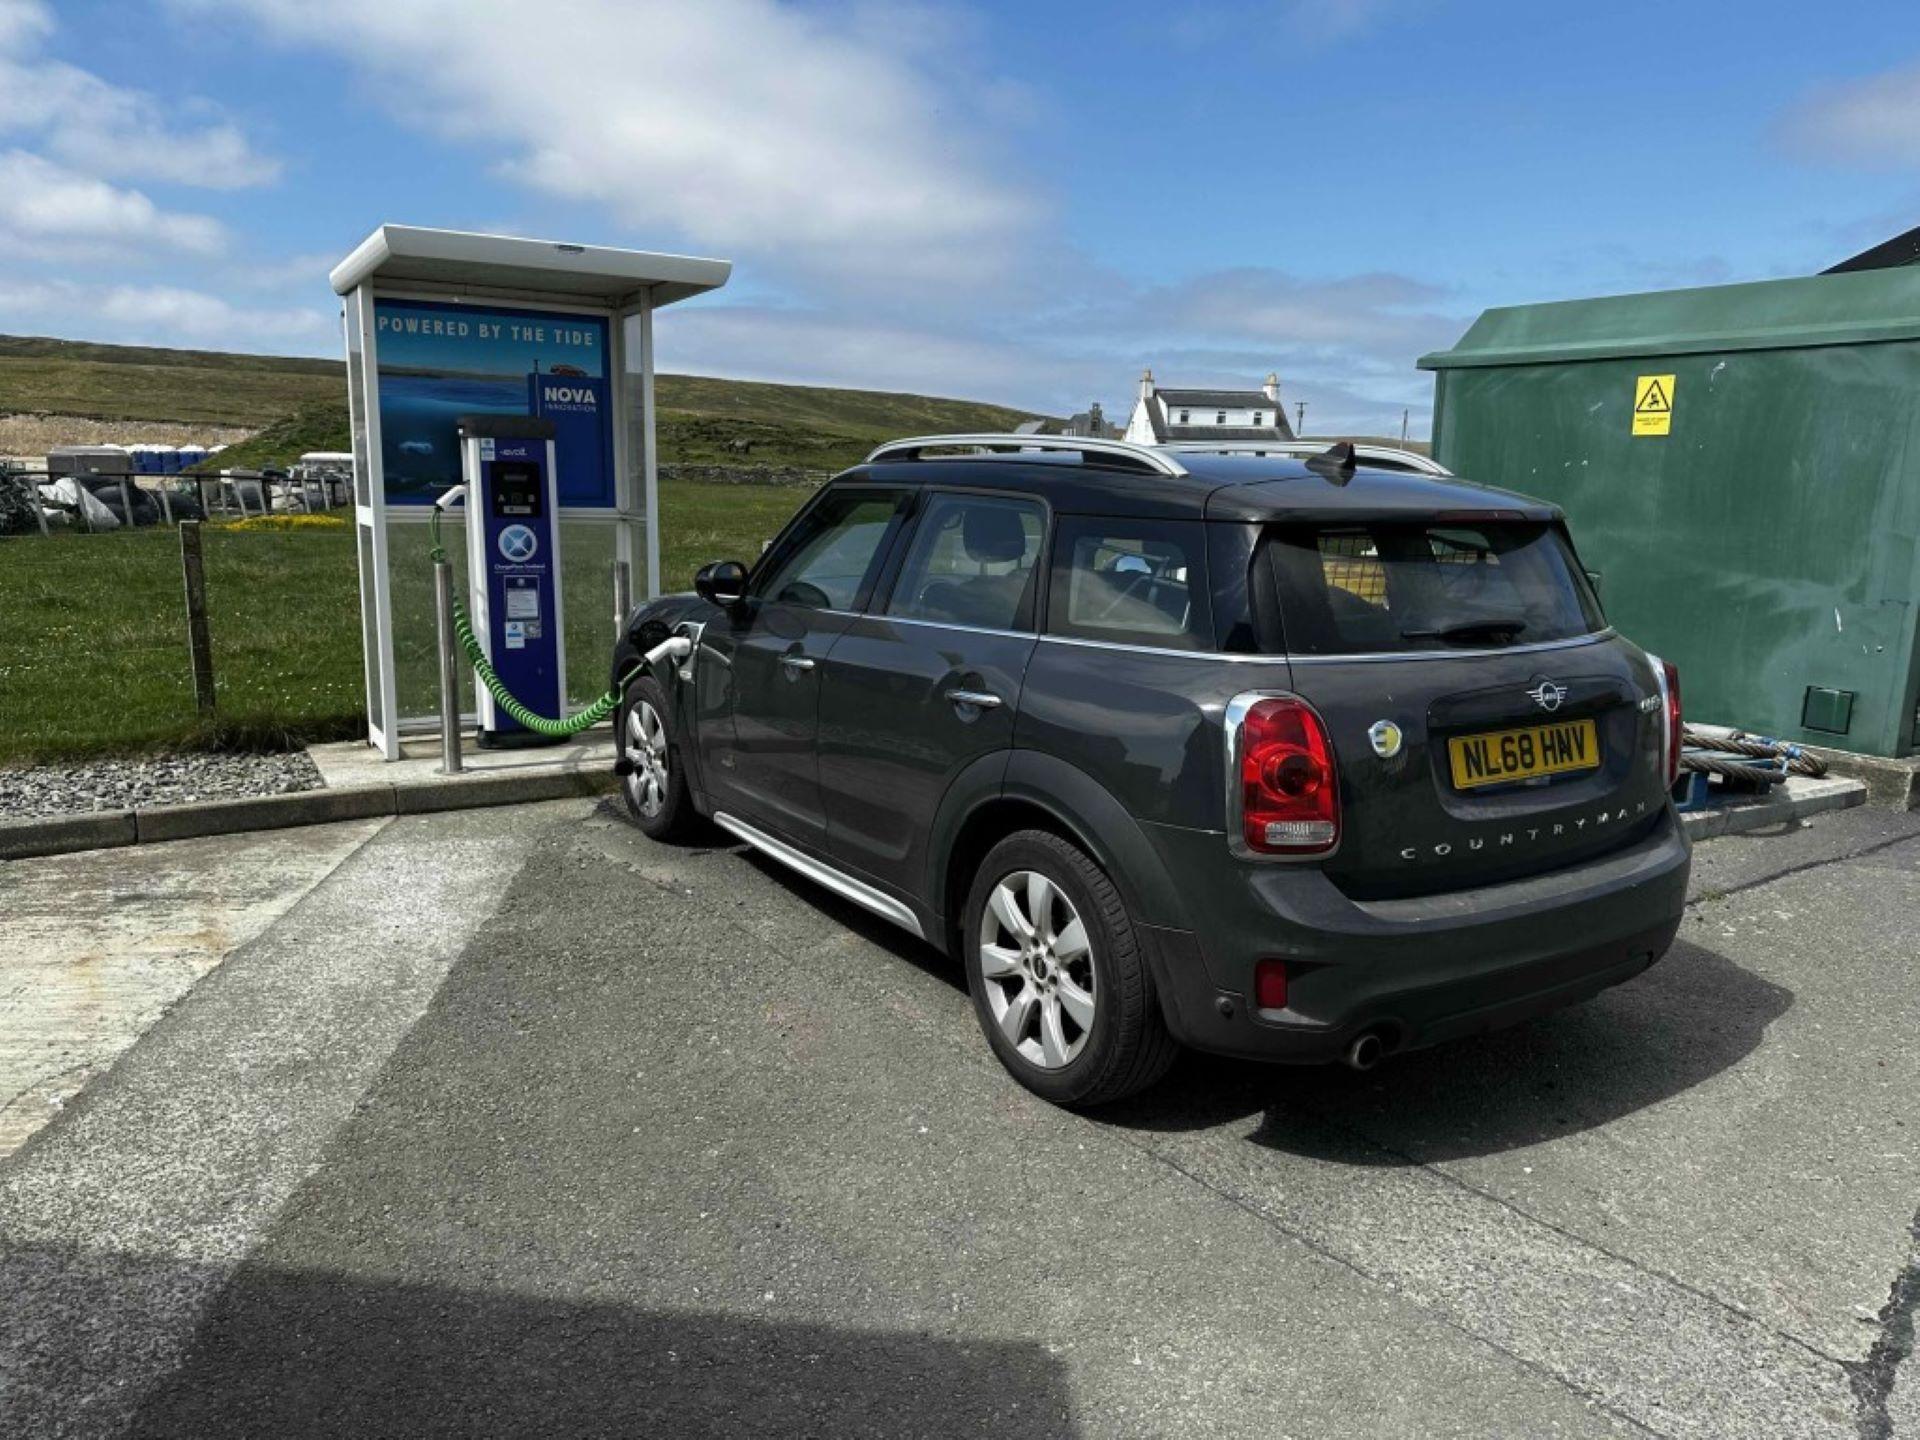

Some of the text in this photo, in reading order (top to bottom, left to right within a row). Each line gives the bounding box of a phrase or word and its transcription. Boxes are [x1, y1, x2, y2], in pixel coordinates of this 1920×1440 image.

[378, 316, 593, 346] POWERED BY THE TIDE
[544, 387, 596, 403] NOVA
[1463, 725, 1586, 778] NL68 HNV
[1401, 801, 1646, 859] COUNTRYMAN
